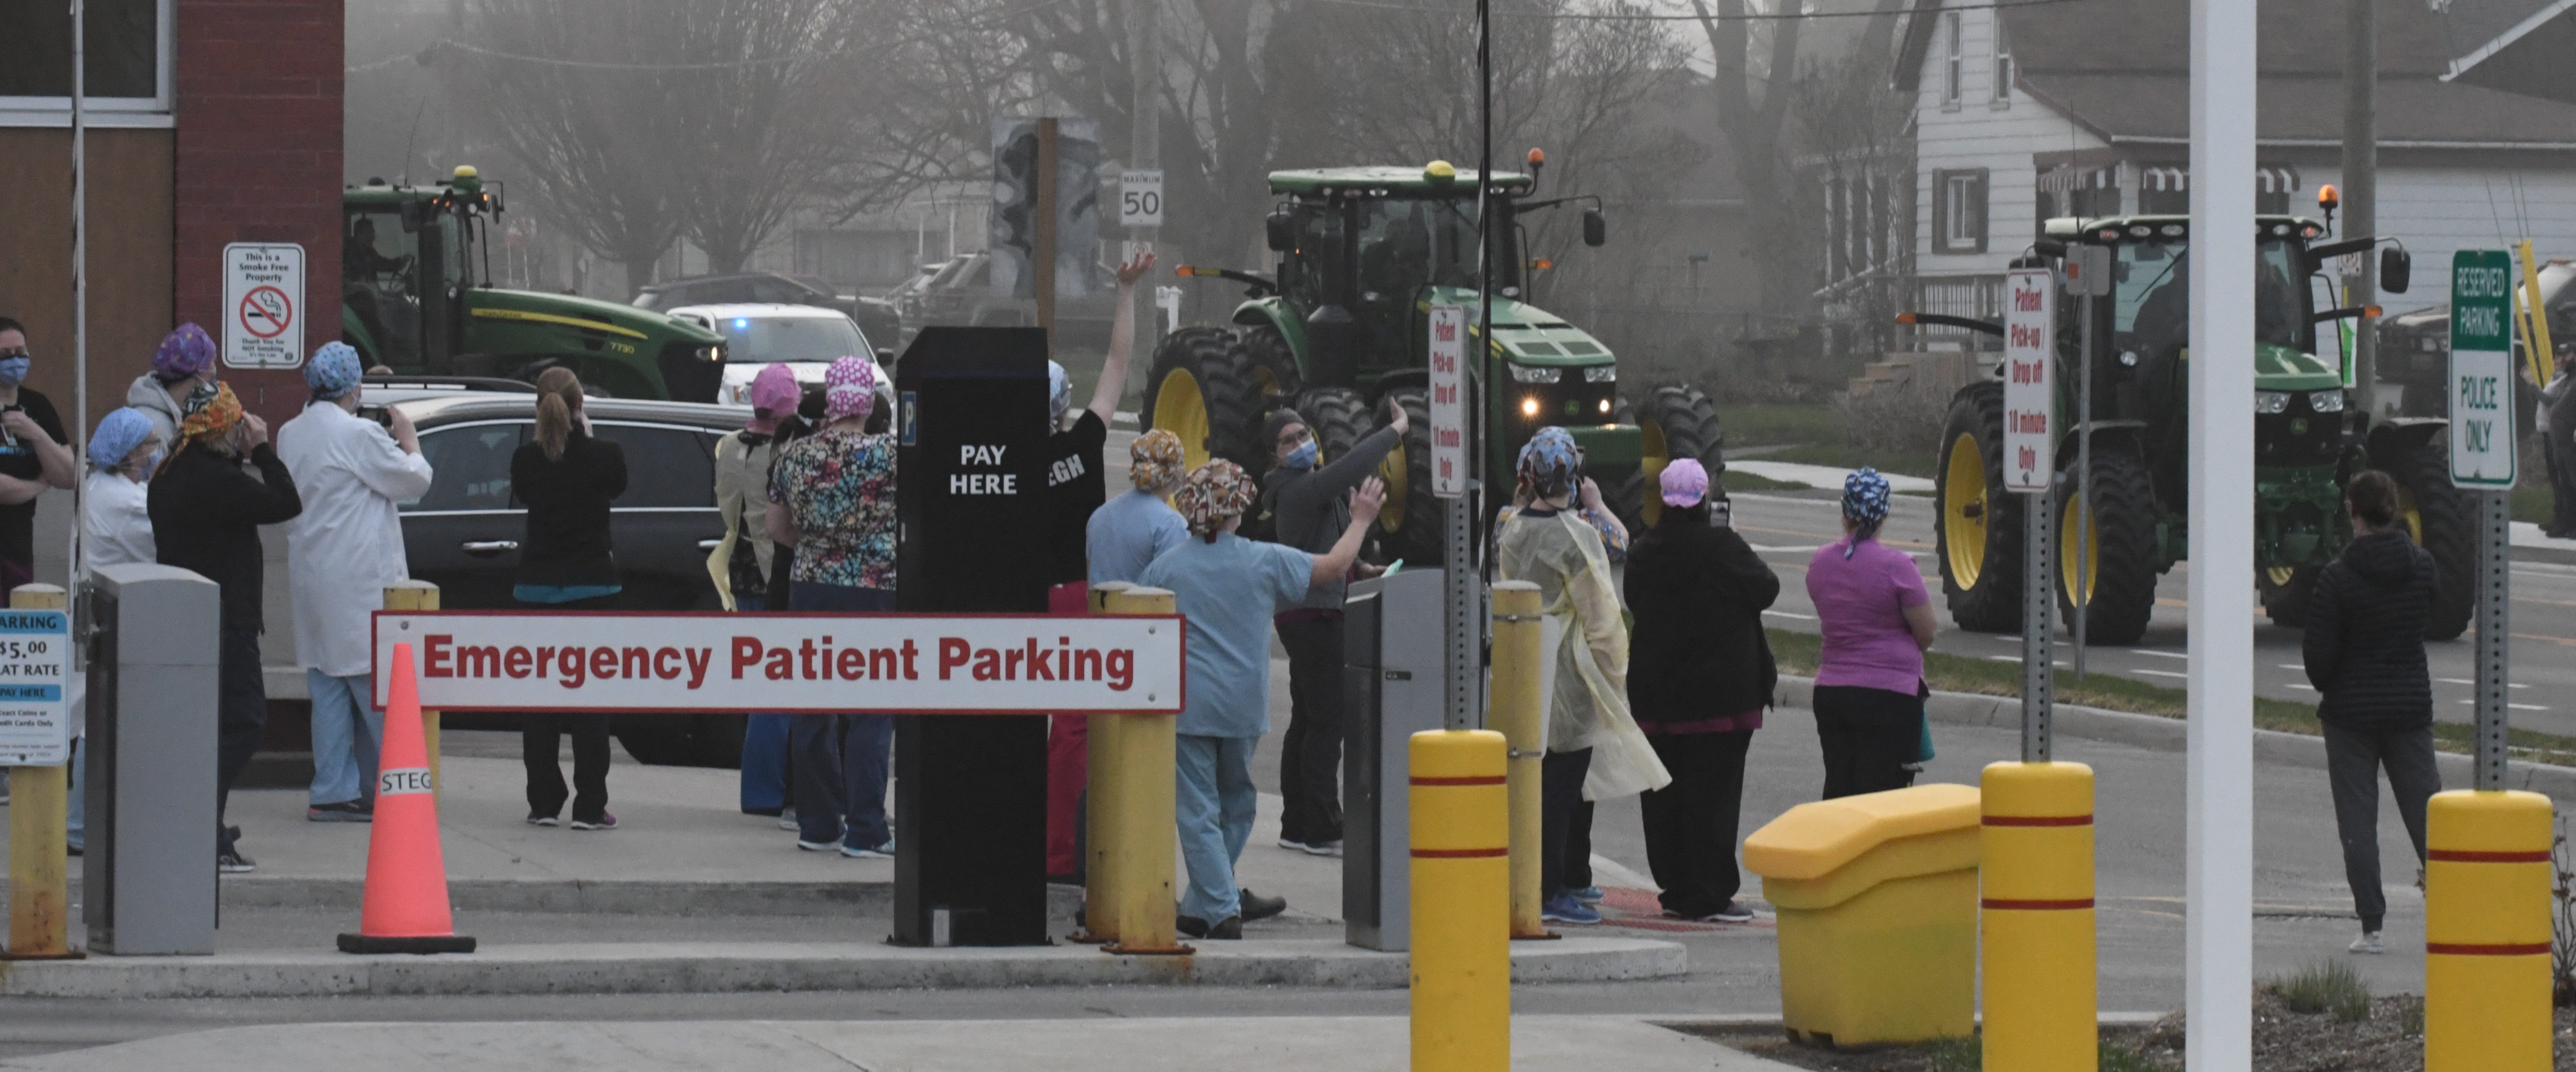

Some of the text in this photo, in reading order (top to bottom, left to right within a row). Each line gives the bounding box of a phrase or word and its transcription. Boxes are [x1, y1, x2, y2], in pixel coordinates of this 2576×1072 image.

[1124, 191, 1159, 215] 50
[246, 273, 282, 282] Property
[2458, 267, 2505, 297] RESERVED
[2016, 287, 2042, 312] Patient
[1436, 319, 1455, 342] Patient
[2460, 307, 2499, 336] PARKING
[2011, 324, 2040, 350] Pick-up
[1434, 351, 1454, 375] Pick-up
[2013, 359, 2042, 386] Drop off
[1435, 382, 1447, 406] Drop
[2461, 376, 2497, 409] POLICE
[905, 401, 913, 435] P
[2009, 409, 2047, 434] 10 minute
[1434, 425, 1459, 448] 10 minute
[2466, 419, 2492, 453] ONLY
[961, 445, 1007, 465] PAY
[2019, 445, 2035, 473] Only
[1440, 456, 1452, 481] Only
[950, 473, 1017, 495] HERE
[0, 640, 47, 659] $5.00
[0, 665, 59, 676] AT RATE
[424, 634, 1134, 691] Emergency Patient Parking
[0, 688, 45, 697] PAY HERE
